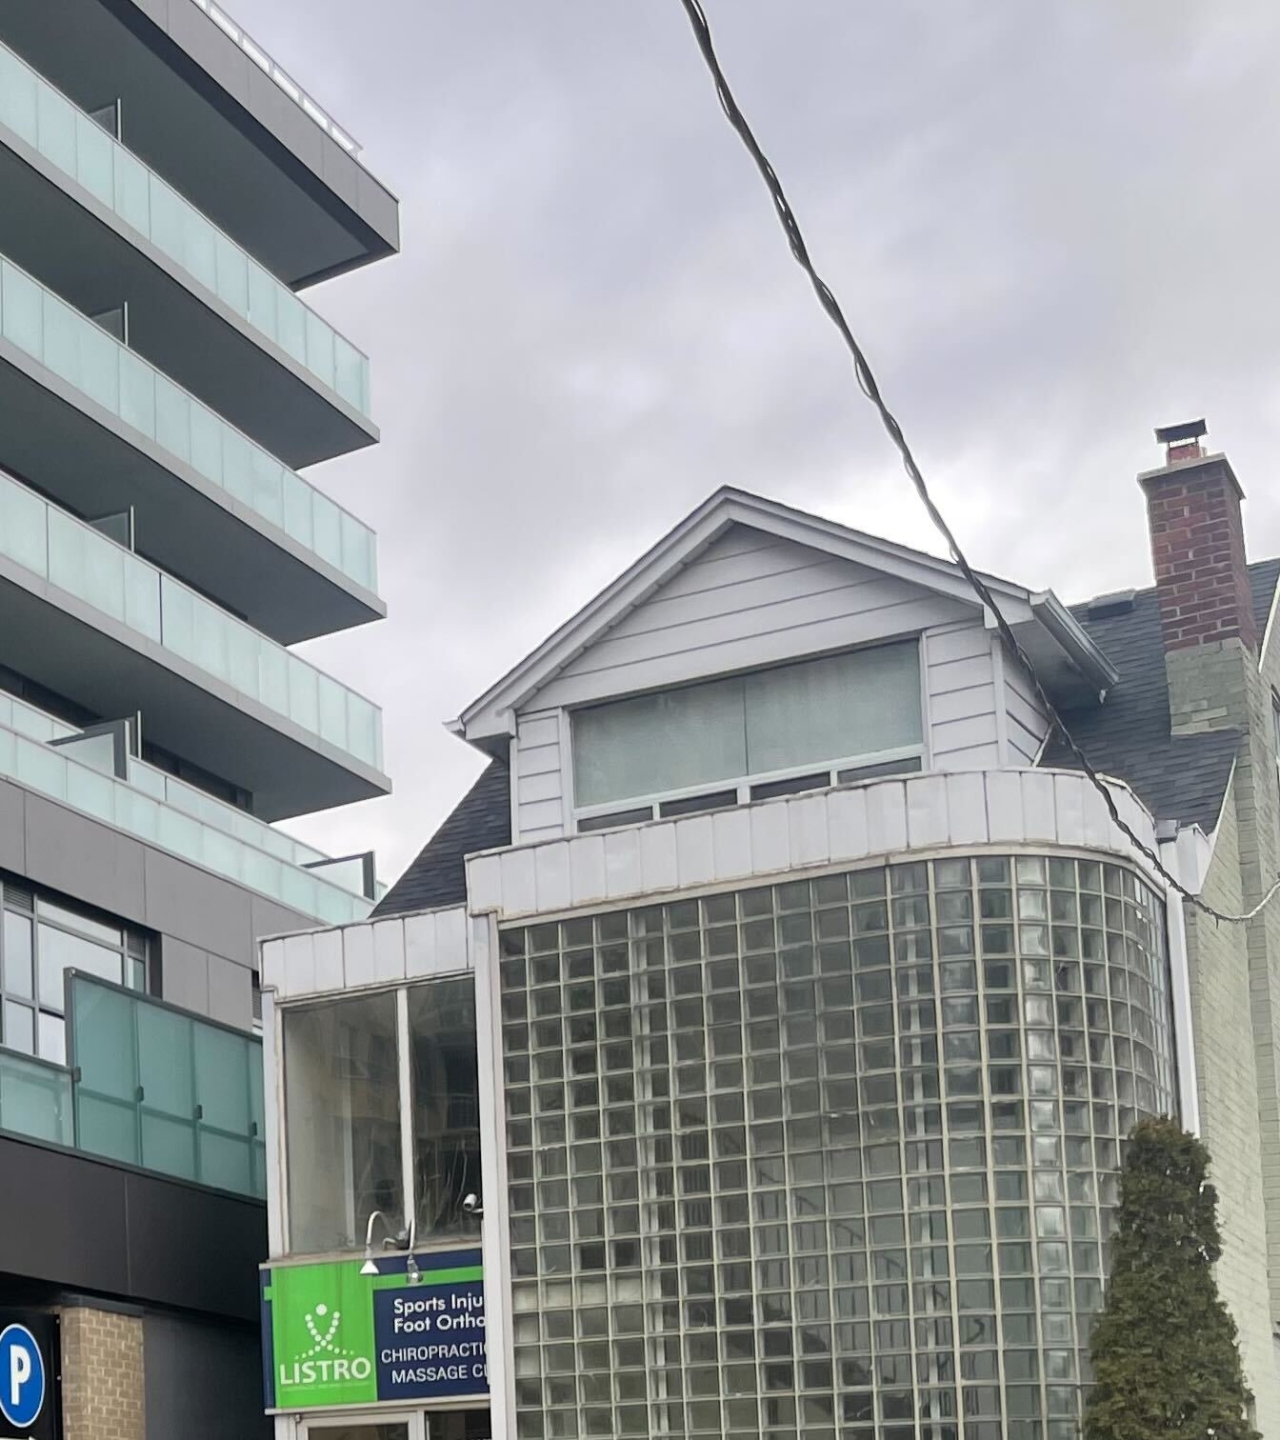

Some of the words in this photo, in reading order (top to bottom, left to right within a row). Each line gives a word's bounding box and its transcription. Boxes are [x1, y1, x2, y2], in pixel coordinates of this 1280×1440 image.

[393, 1297, 446, 1317] Sports
[451, 1292, 483, 1312] Inju
[394, 1316, 431, 1334] Foot
[381, 1342, 487, 1363] CHIROPRACTI
[9, 1344, 31, 1406] P
[392, 1365, 468, 1384] MASSAGE
